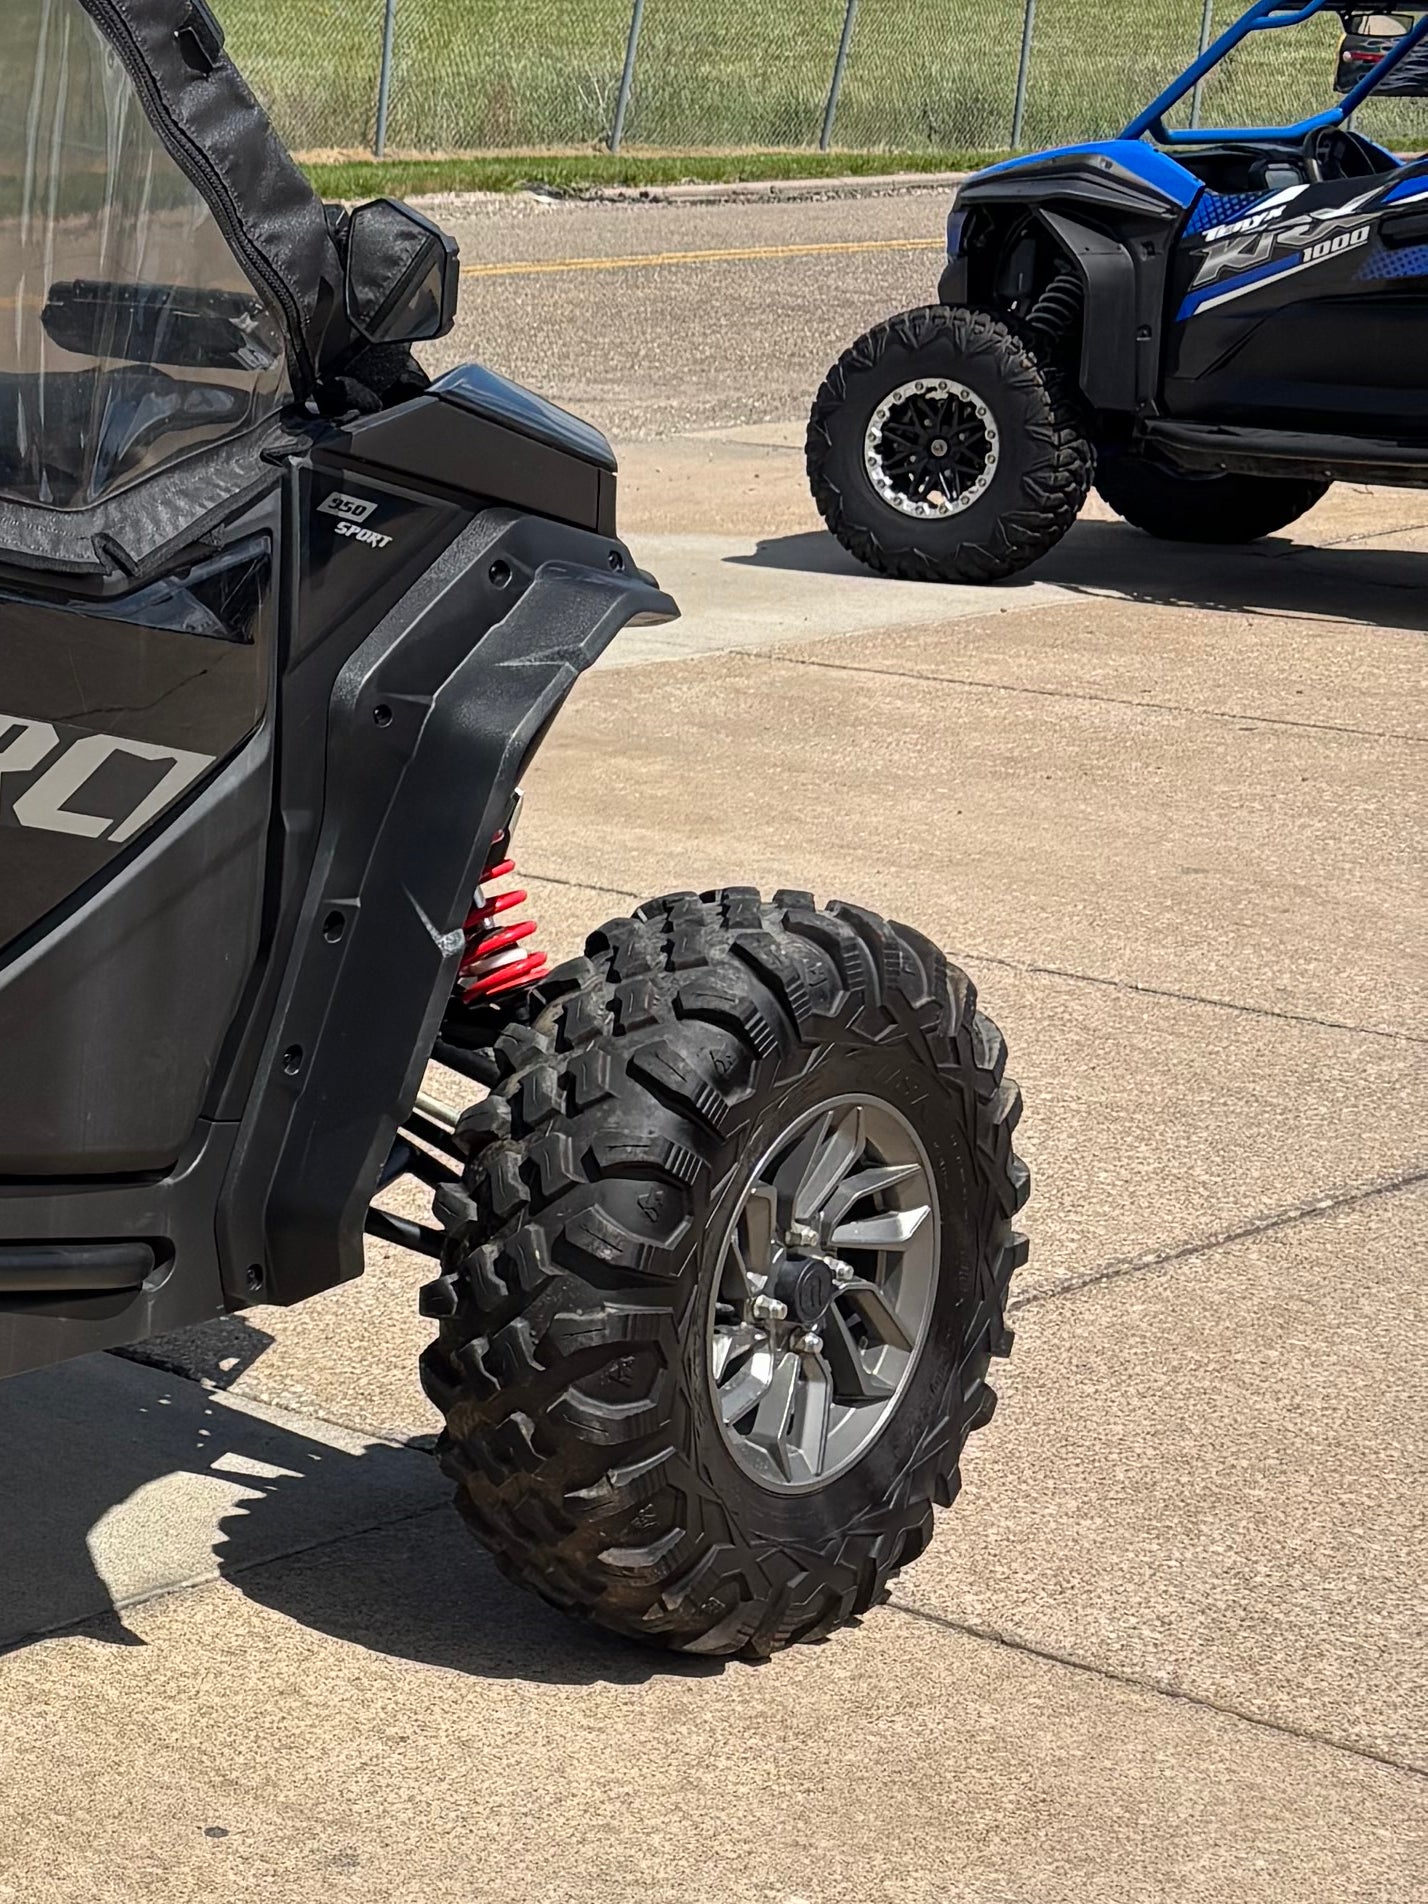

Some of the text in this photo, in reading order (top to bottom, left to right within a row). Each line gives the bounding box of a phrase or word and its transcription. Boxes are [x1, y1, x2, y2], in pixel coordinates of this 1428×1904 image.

[1302, 225, 1371, 263] 1000
[328, 497, 368, 517] 950
[334, 520, 394, 549] SPORT
